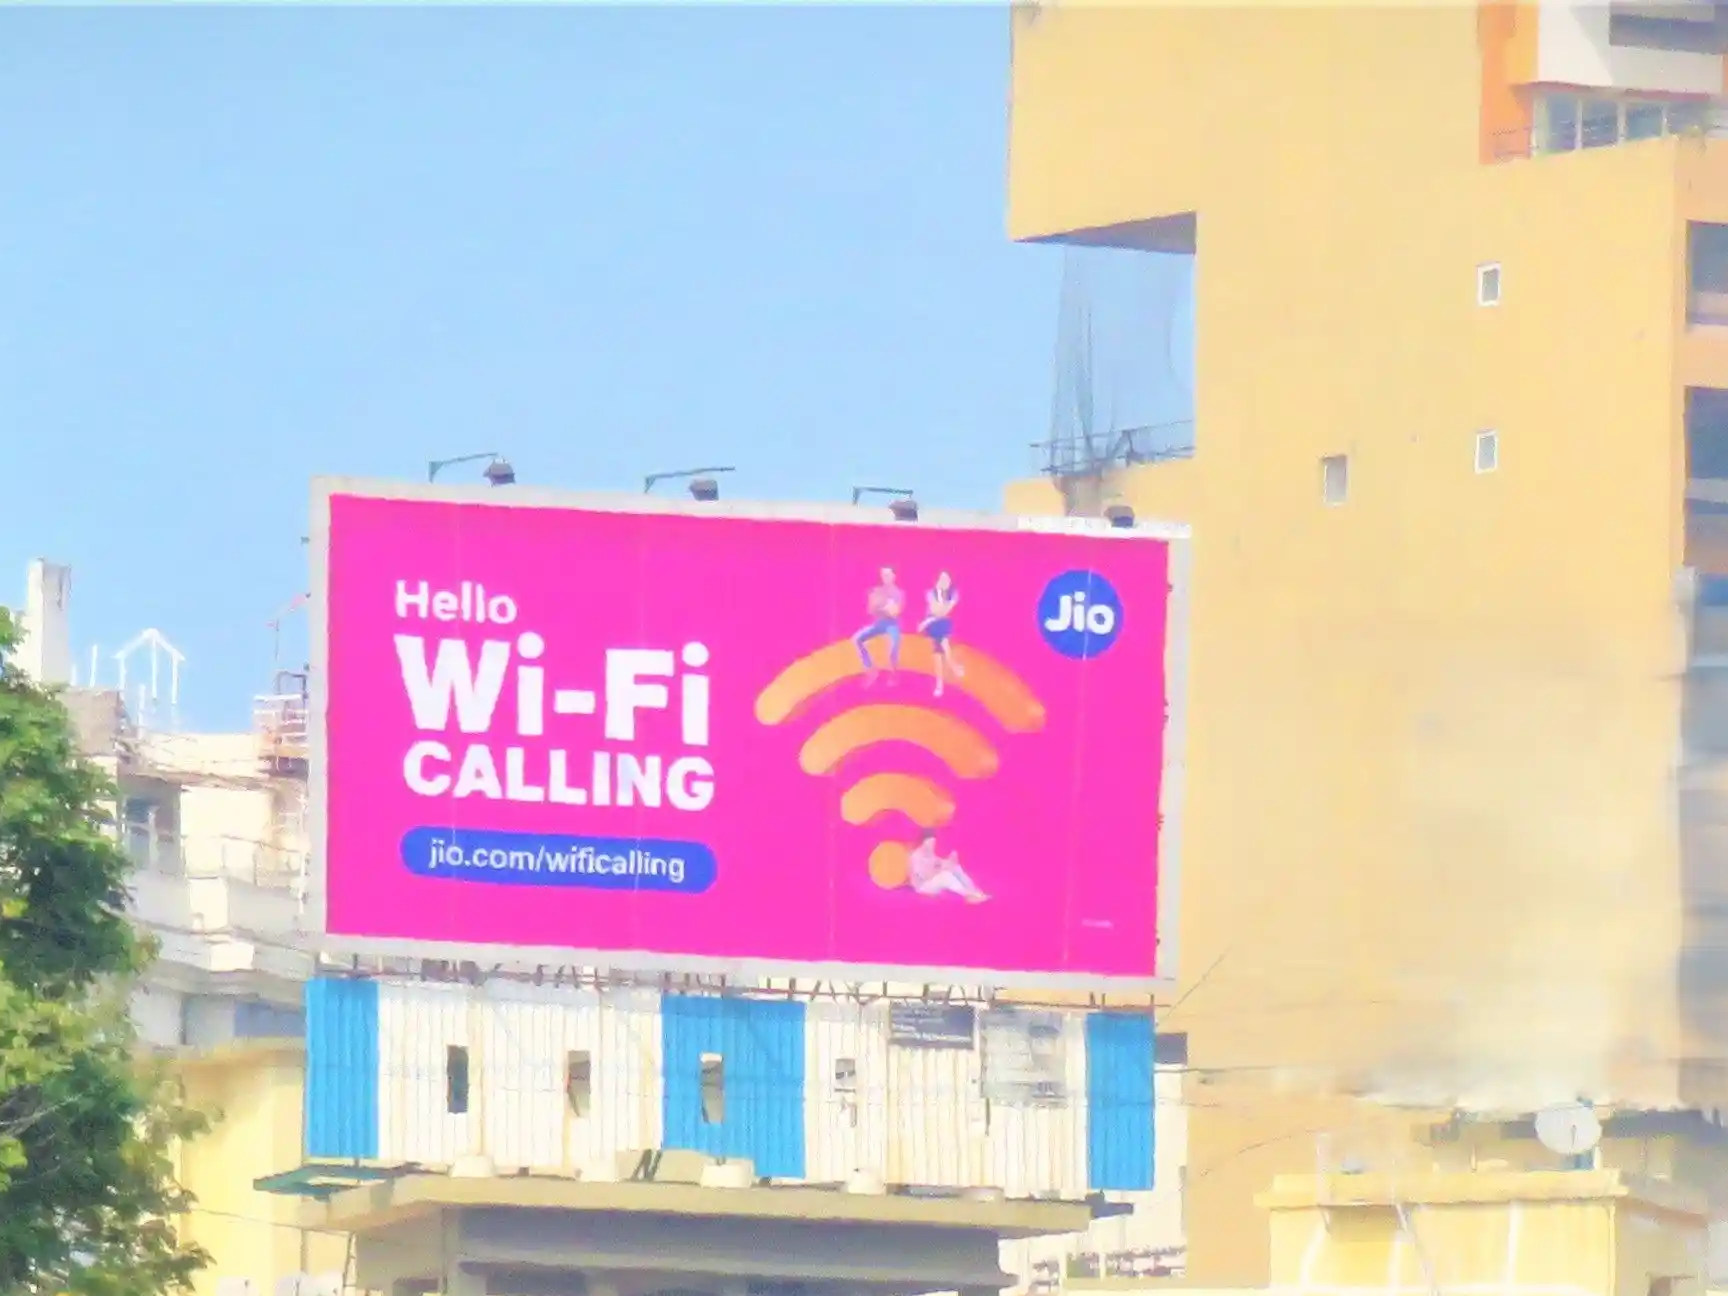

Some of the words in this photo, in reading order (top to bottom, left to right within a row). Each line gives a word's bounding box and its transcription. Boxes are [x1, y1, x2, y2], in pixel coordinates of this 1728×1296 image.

[395, 580, 518, 625] Hello
[1043, 591, 1116, 636] Jio
[393, 632, 712, 747] Wi-Fi
[403, 740, 715, 812] CALLING
[428, 838, 685, 884] jio.com/wificalling
